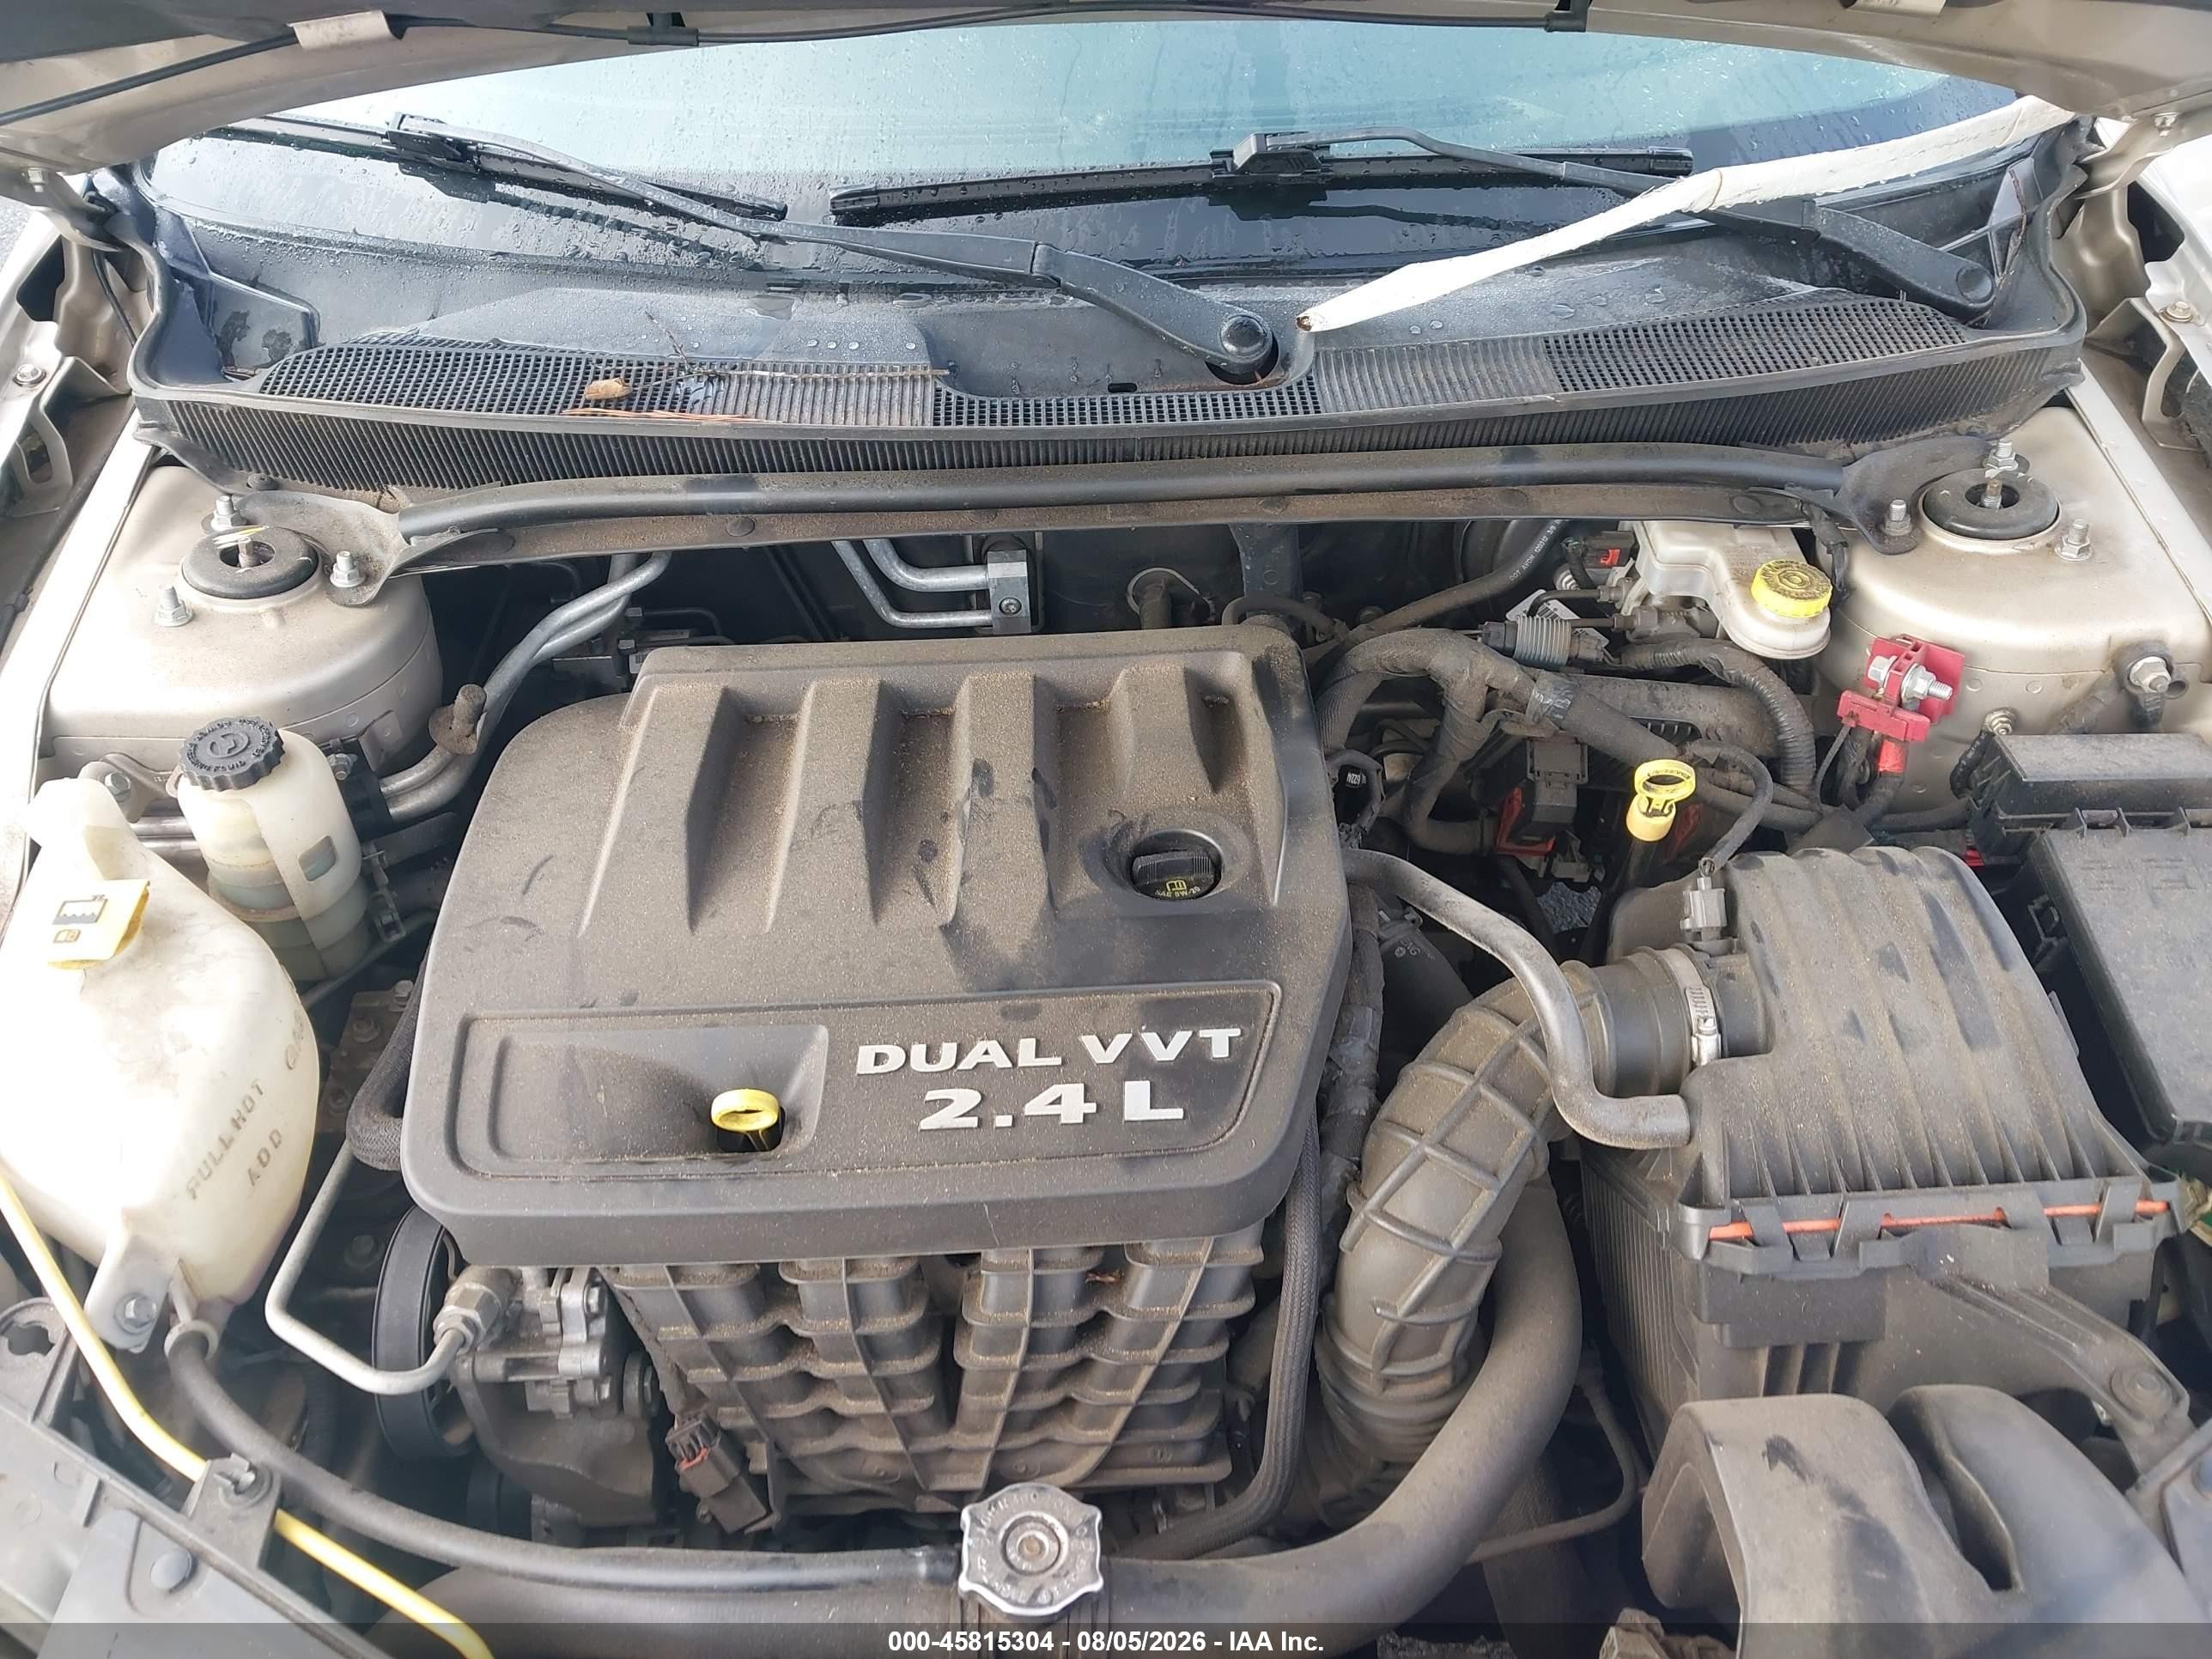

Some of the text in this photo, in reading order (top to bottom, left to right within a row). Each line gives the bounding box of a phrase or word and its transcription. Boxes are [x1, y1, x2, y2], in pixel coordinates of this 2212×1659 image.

[1522, 554, 1535, 570] AVON
[856, 1028, 1241, 1075] DUAL VVT
[920, 1080, 1184, 1131] 2.4 L
